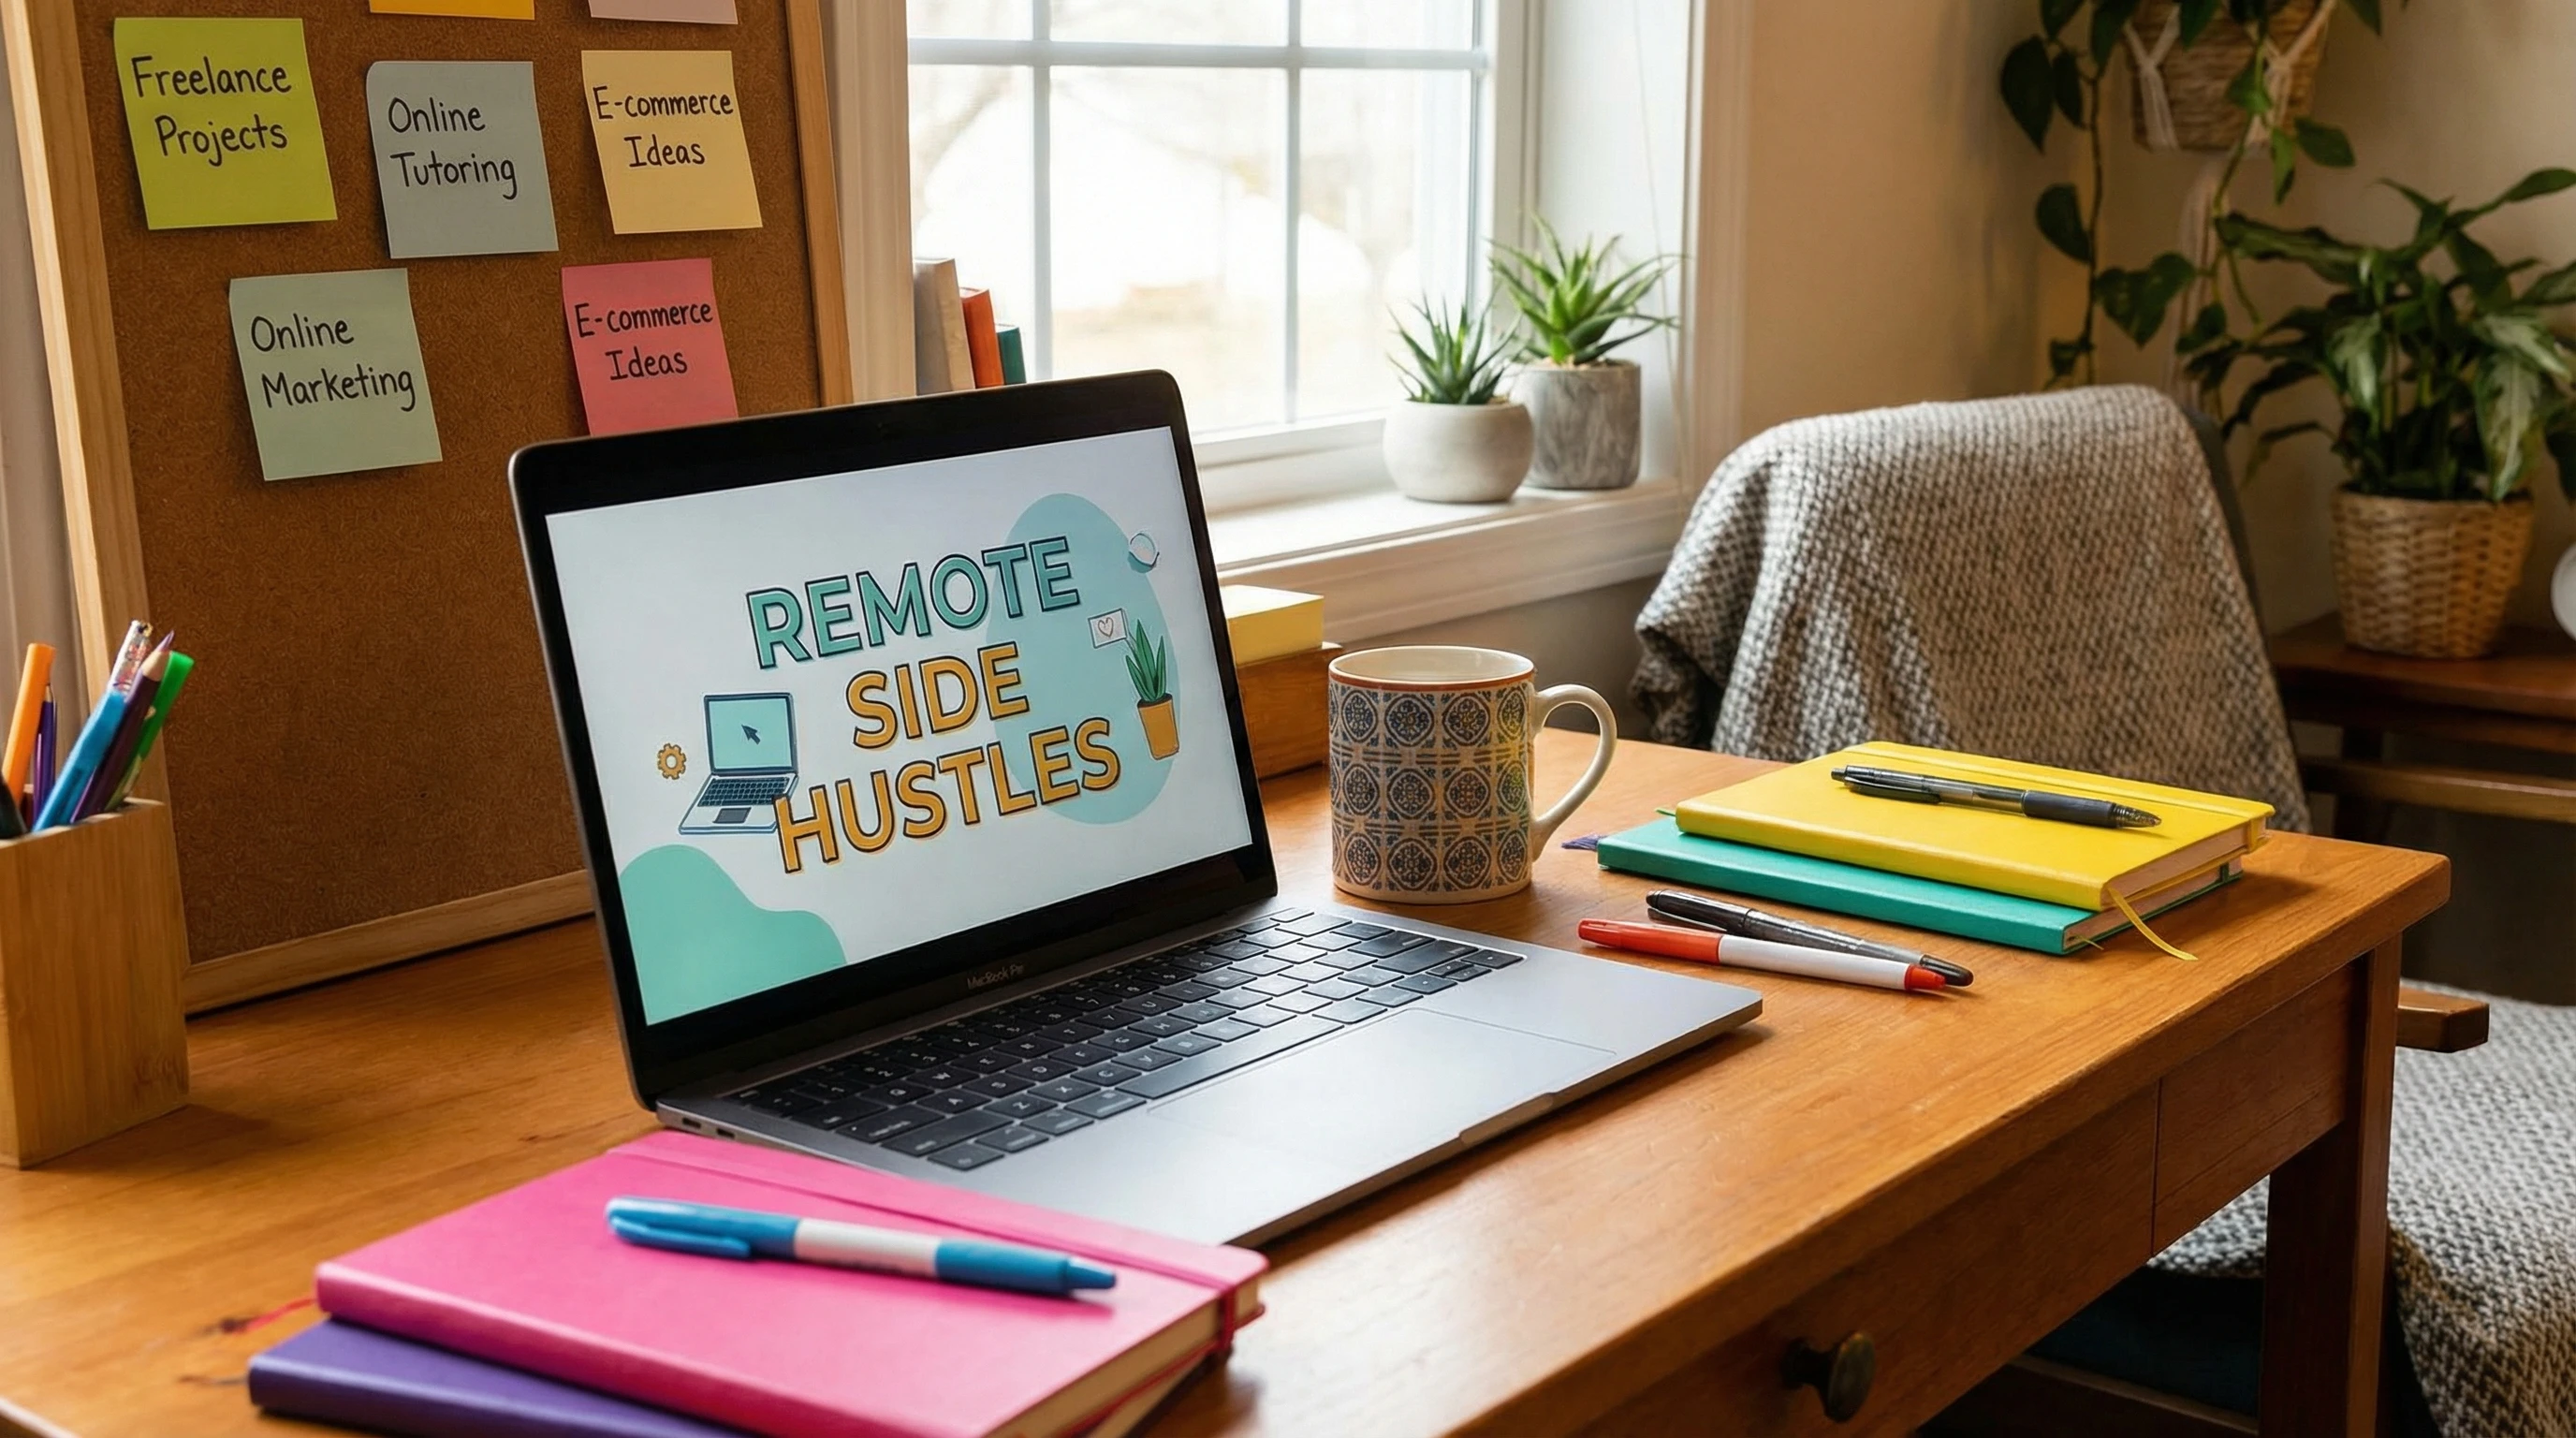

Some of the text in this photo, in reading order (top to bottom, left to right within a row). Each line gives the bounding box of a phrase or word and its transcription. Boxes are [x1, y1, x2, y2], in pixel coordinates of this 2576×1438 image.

[130, 54, 292, 97] Freelance
[387, 96, 487, 134] Online
[592, 84, 735, 121] E-commerce
[154, 113, 288, 168] Projects
[623, 134, 707, 168] Ideas
[389, 150, 518, 200] Tutoring
[250, 313, 356, 352] Online
[574, 301, 714, 338] E-commerce
[604, 345, 689, 381] Ideas
[260, 363, 417, 412] Marketing
[745, 535, 1081, 670] REMOTE
[844, 640, 1031, 751] SIDE
[773, 716, 1121, 874] HUSTLES
